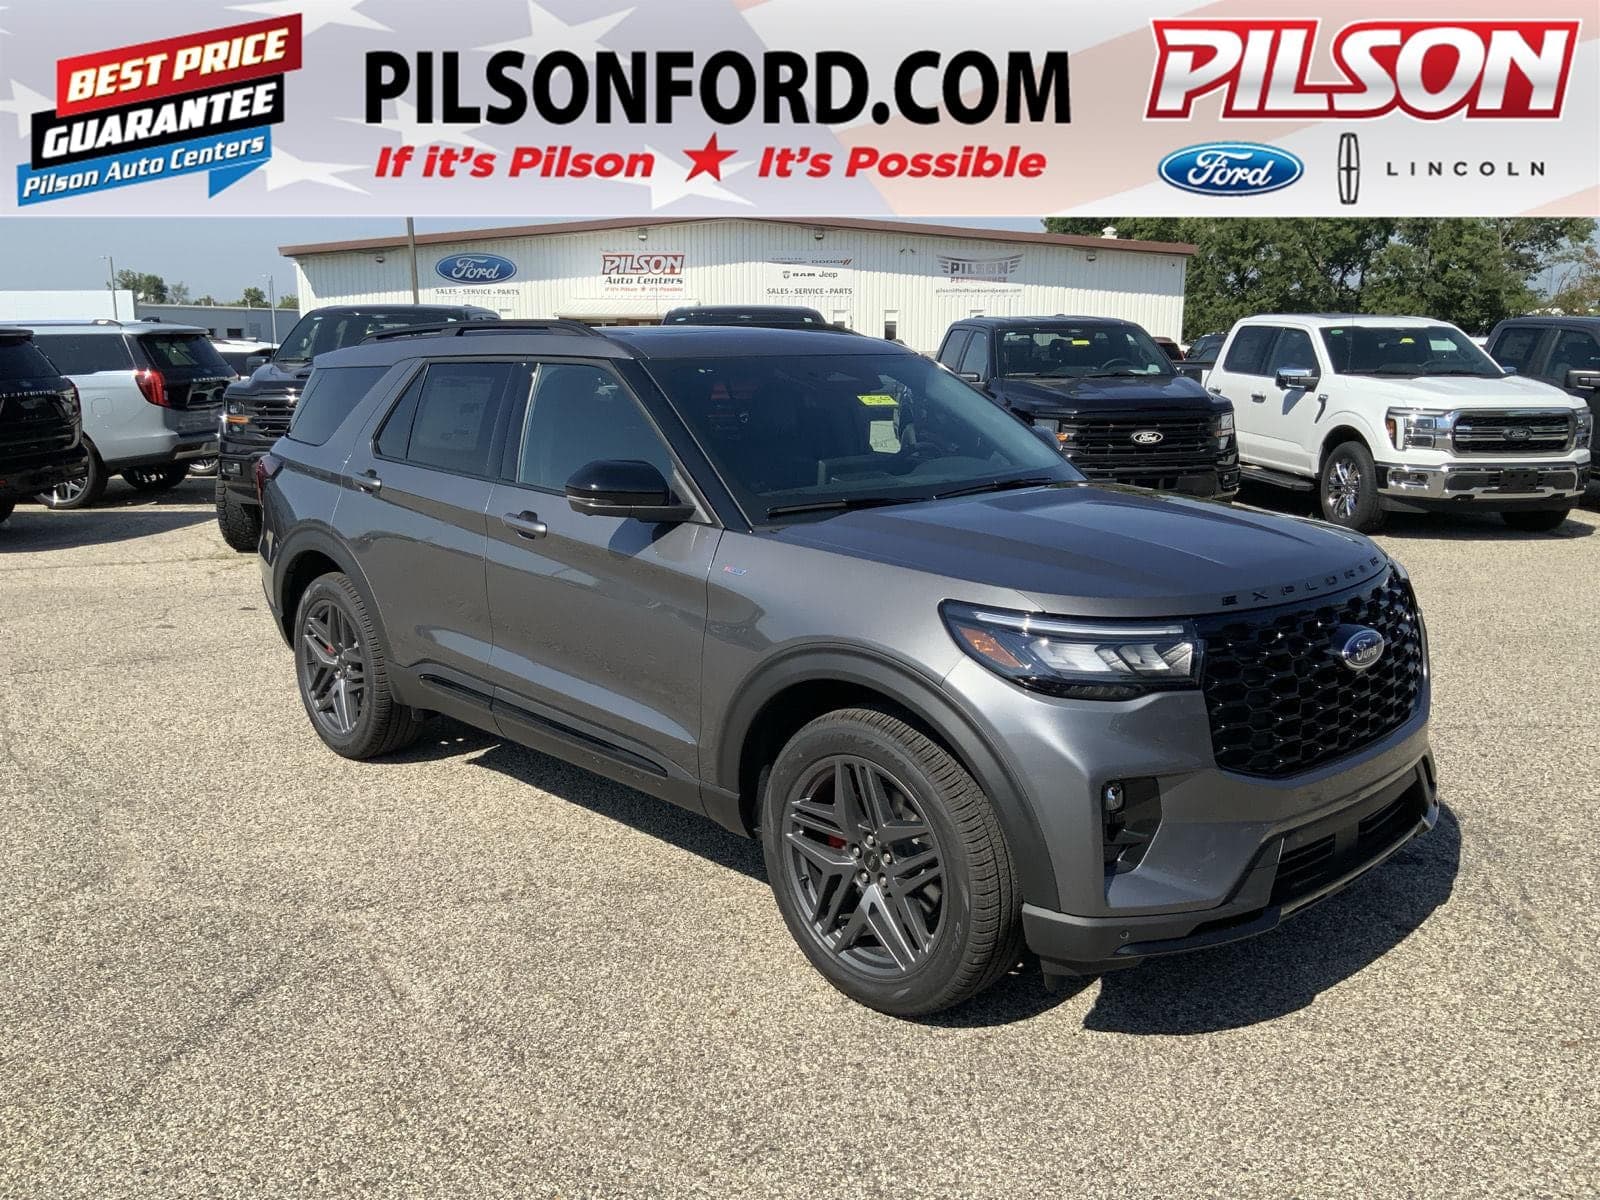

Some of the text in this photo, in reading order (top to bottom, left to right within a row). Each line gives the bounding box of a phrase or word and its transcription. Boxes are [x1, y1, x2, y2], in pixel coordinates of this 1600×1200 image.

[452, 257, 500, 279] Ford
[602, 254, 685, 275] PILSON
[950, 261, 1009, 274] PILSON
[818, 270, 838, 278] Jeep
[605, 276, 684, 284] Auto Centers
[497, 288, 520, 296] PARTS
[794, 287, 825, 295] SERVICE
[829, 287, 853, 295] PARTS
[1221, 556, 1380, 607] EXPLORER
